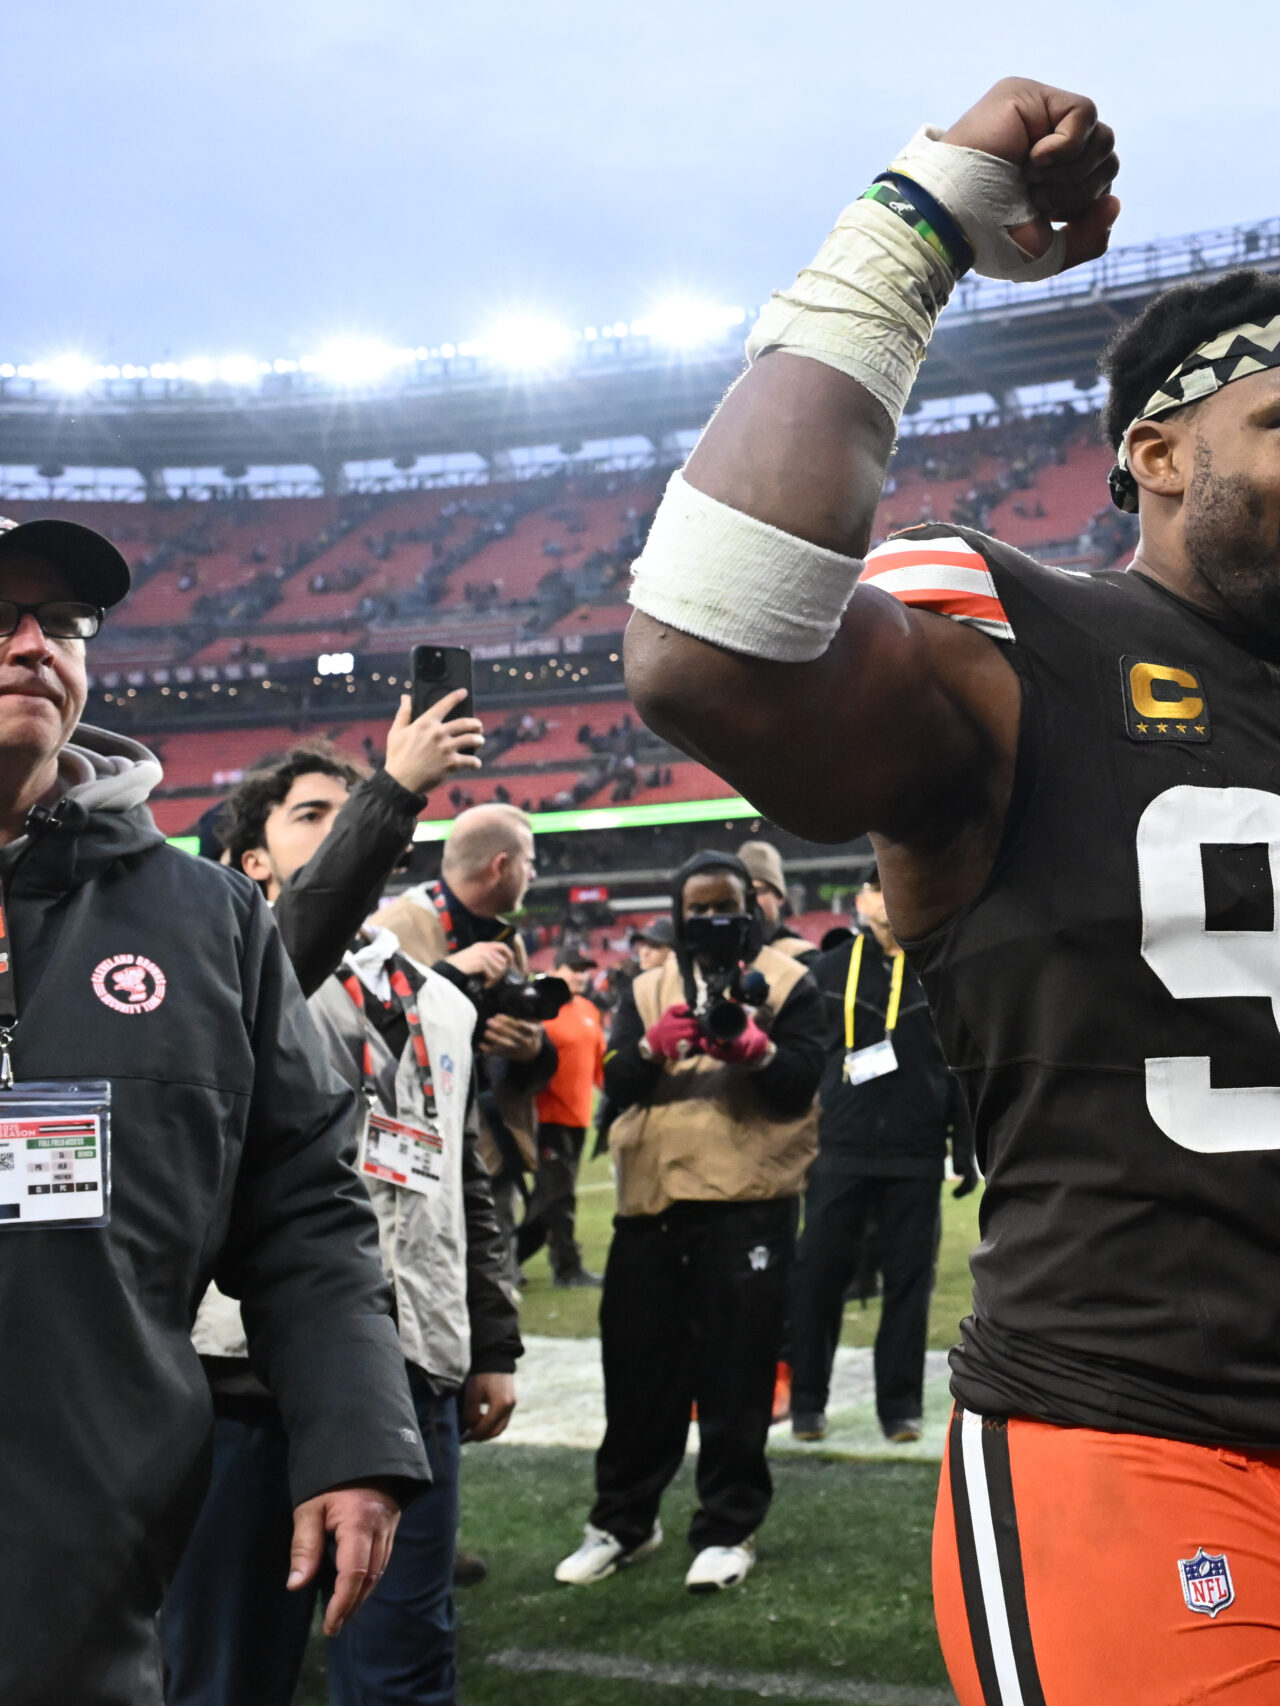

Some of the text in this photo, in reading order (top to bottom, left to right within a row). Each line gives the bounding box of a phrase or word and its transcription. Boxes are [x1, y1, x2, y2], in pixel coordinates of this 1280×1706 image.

[1130, 662, 1204, 720] C
[91, 953, 135, 984] CLEVELAND
[135, 954, 167, 985] BROWNS
[1192, 1577, 1228, 1604] NFL
